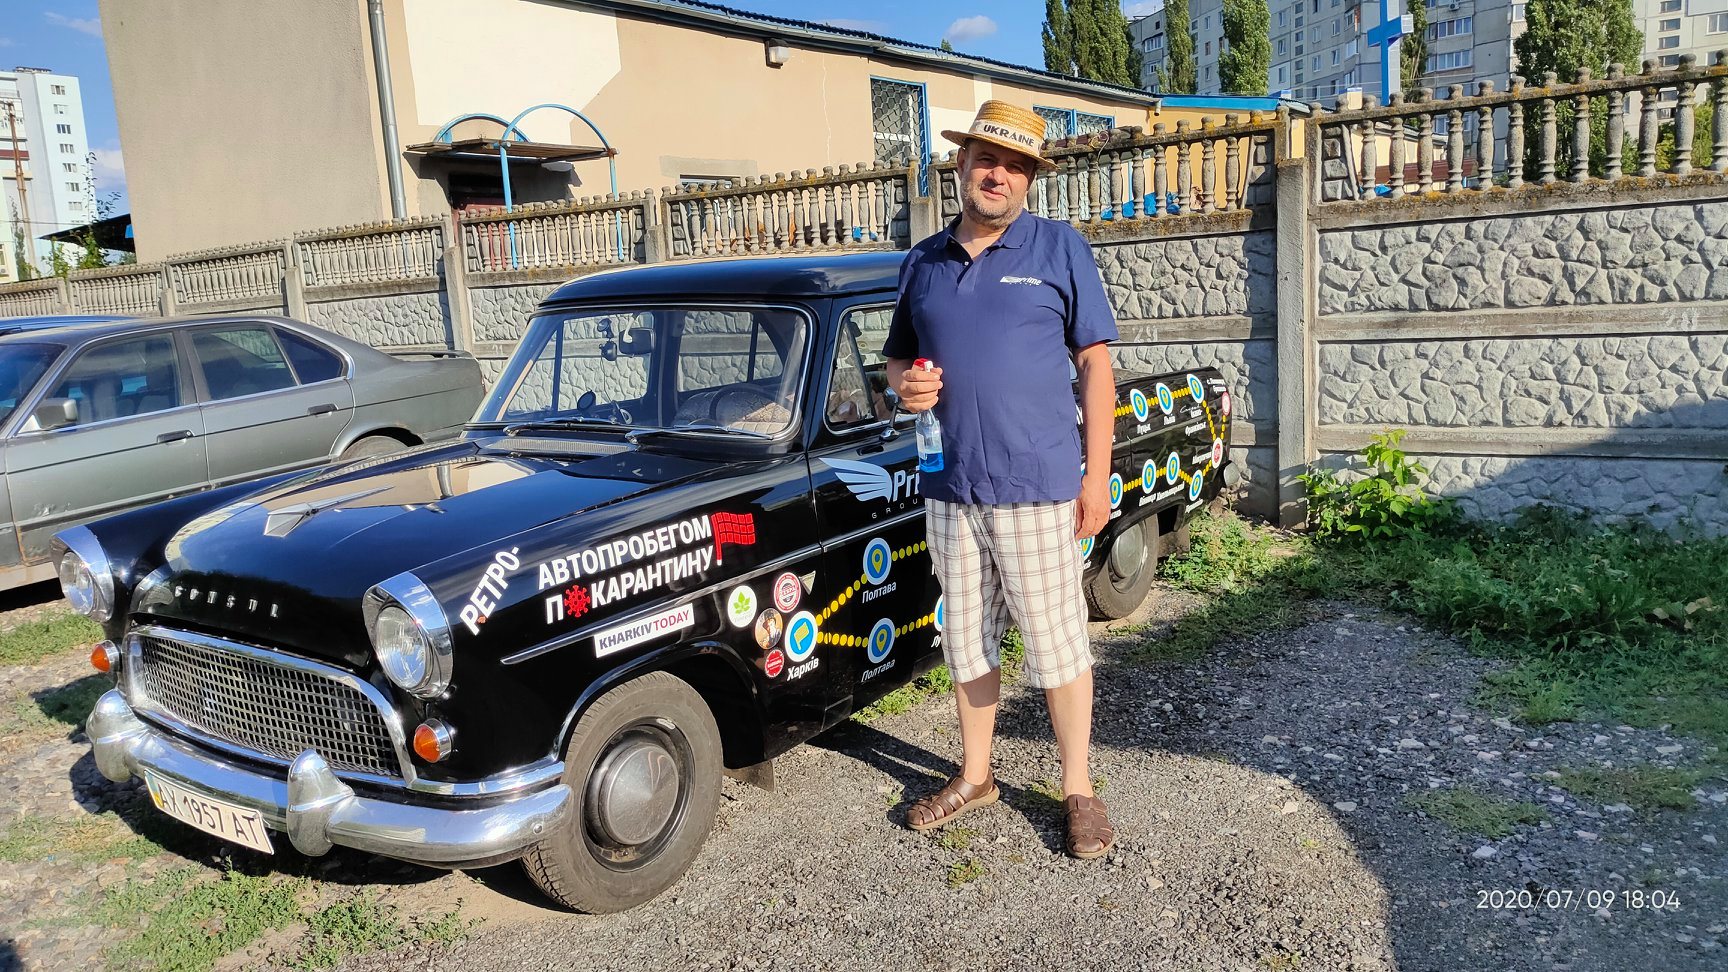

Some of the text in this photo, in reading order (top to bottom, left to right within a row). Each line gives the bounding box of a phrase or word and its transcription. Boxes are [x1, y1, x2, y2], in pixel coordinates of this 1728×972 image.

[983, 124, 1035, 147] UKRAINE
[892, 465, 920, 502] Pri
[871, 498, 918, 519] GROU
[538, 514, 712, 590] АВТОПРОБЕГОМ
[459, 546, 519, 636] РЕТРО-
[590, 545, 714, 609] КАРАНТИНУ
[861, 581, 897, 604] Полтава
[786, 655, 820, 682] Харків
[860, 658, 896, 683] Полтава
[157, 783, 259, 844] AX 1957 AT
